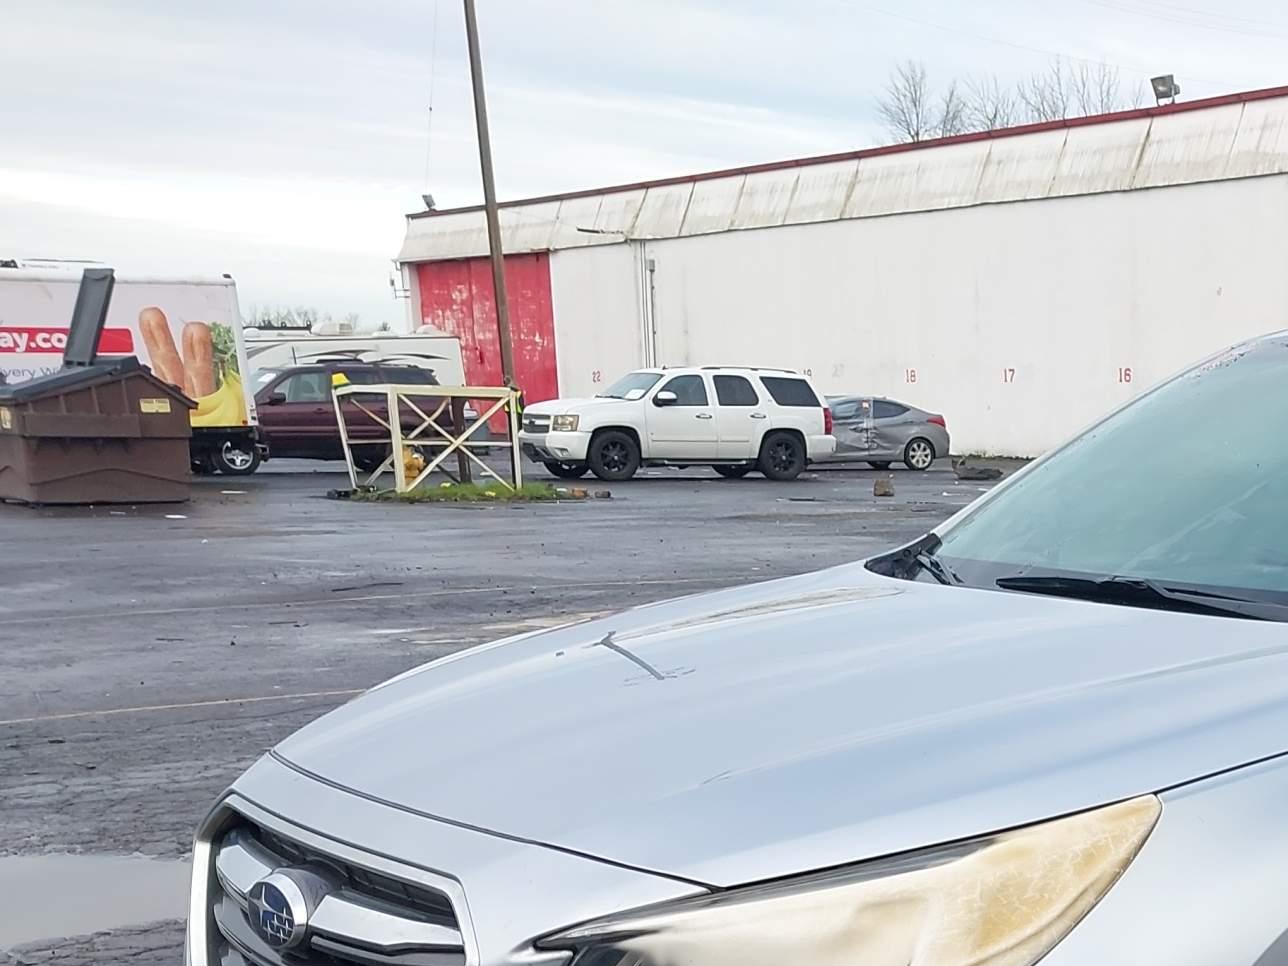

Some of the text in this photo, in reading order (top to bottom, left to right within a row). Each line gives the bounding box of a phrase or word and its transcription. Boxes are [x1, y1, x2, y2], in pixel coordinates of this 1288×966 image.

[592, 370, 601, 383] 22
[905, 369, 917, 383] 18
[1003, 369, 1015, 383] 17
[1118, 368, 1131, 383] 16
